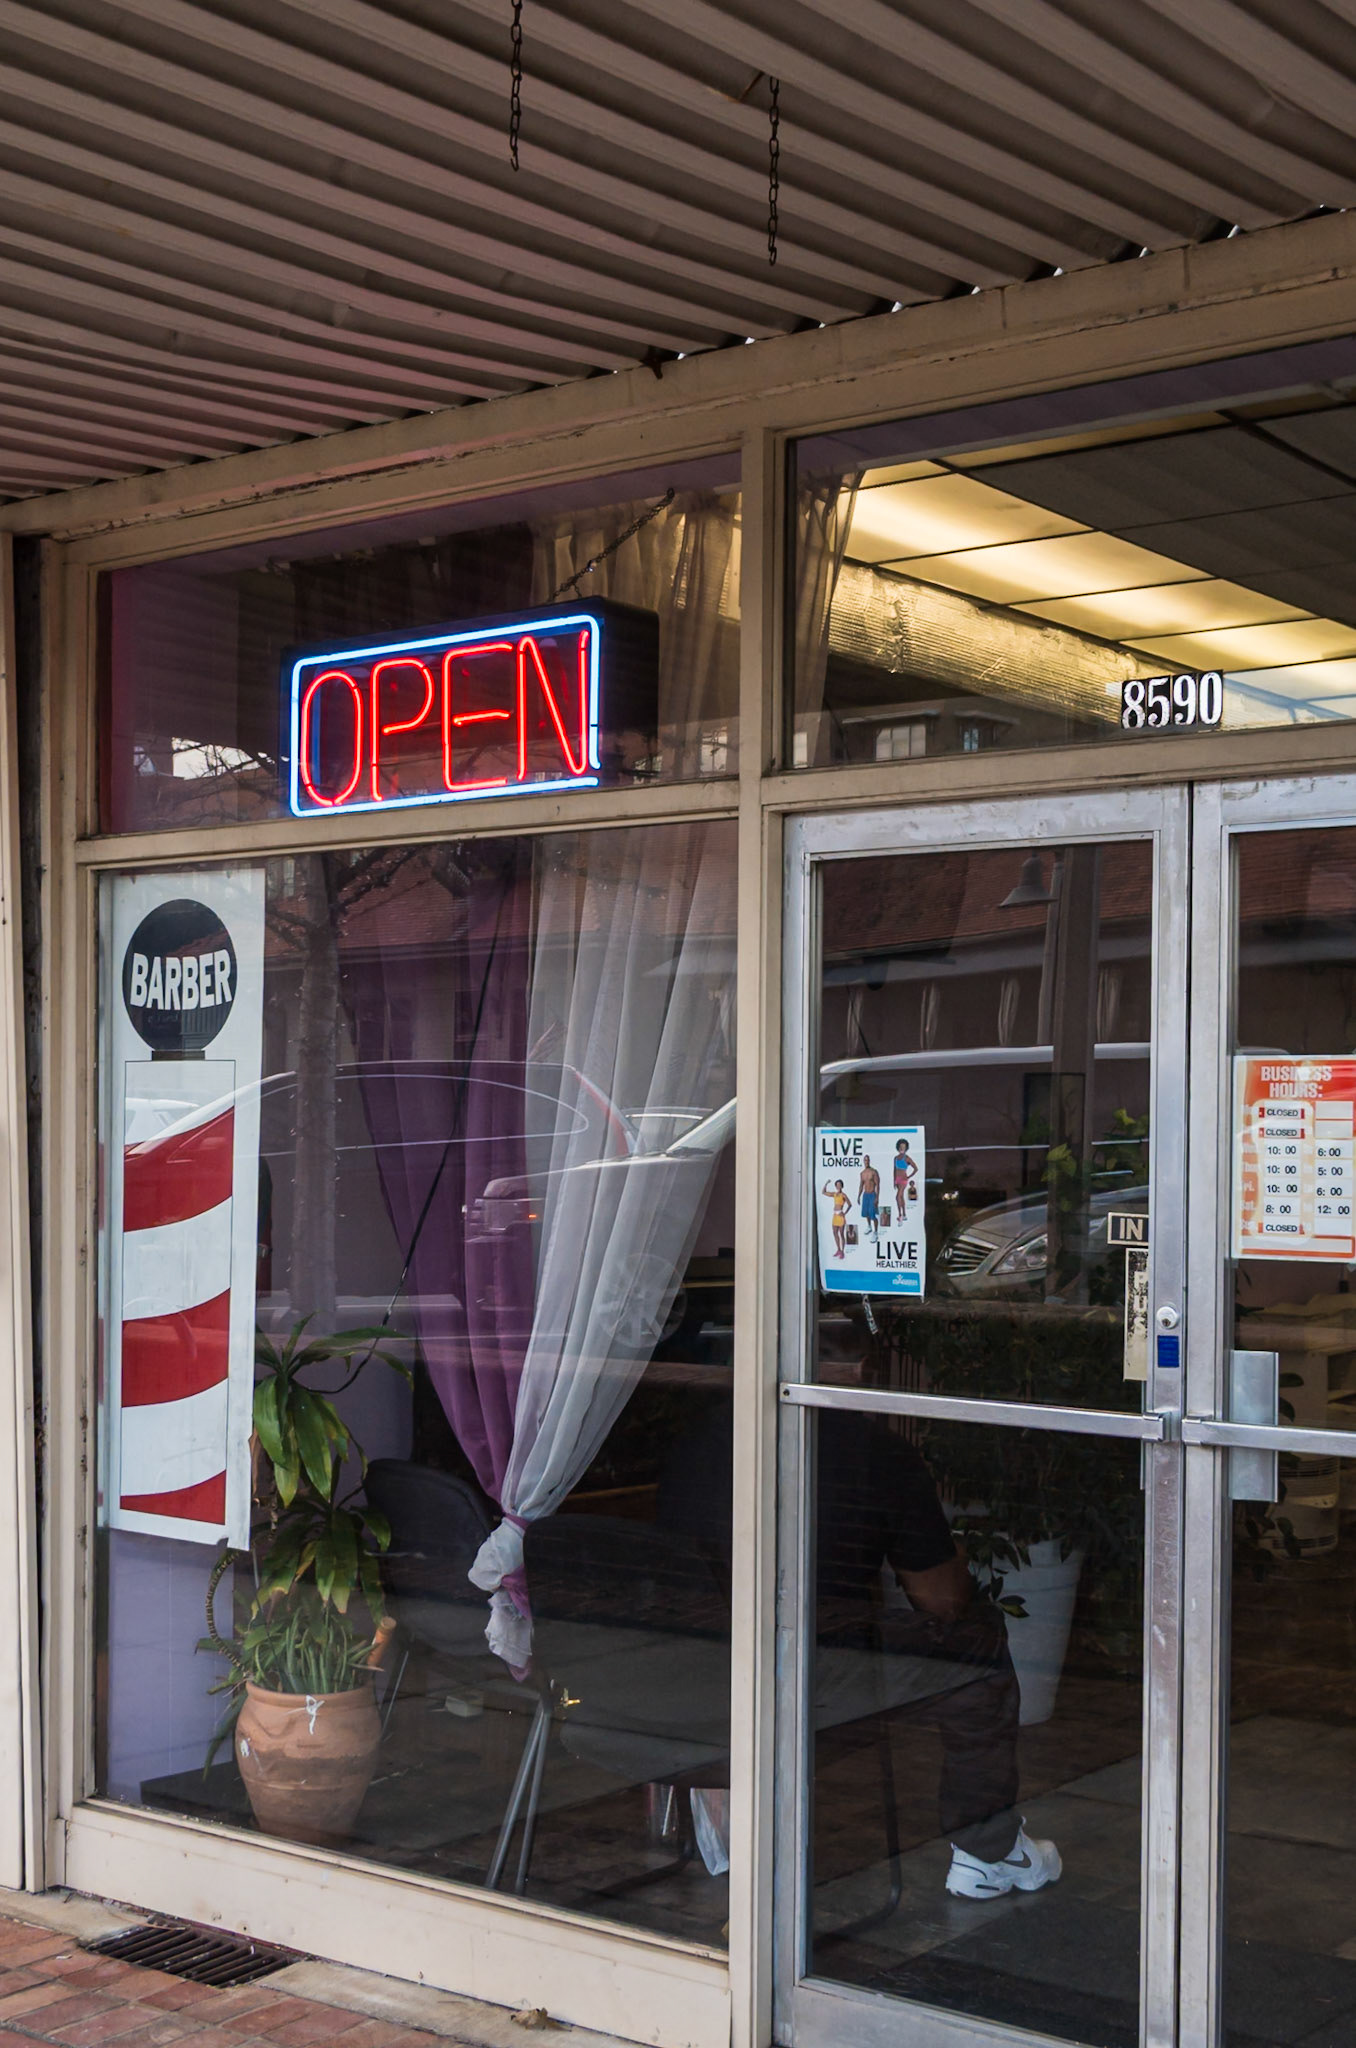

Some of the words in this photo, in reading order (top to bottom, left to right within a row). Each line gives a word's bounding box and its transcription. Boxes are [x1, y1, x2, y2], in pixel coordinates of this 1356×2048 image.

[1122, 672, 1222, 729] 8590
[300, 630, 591, 807] OPEN
[130, 949, 233, 1011] BARBER
[1261, 1065, 1332, 1081] BUSINSS
[1266, 1108, 1298, 1117] CLOSED
[1265, 1129, 1298, 1137] CLOSED
[822, 1138, 863, 1156] LIVE
[822, 1157, 863, 1168] LONGER.
[1119, 1217, 1143, 1241] IN
[1265, 1224, 1298, 1232] CLOSED
[876, 1241, 918, 1260] LIVE
[876, 1260, 918, 1269] HEALTHIER.
